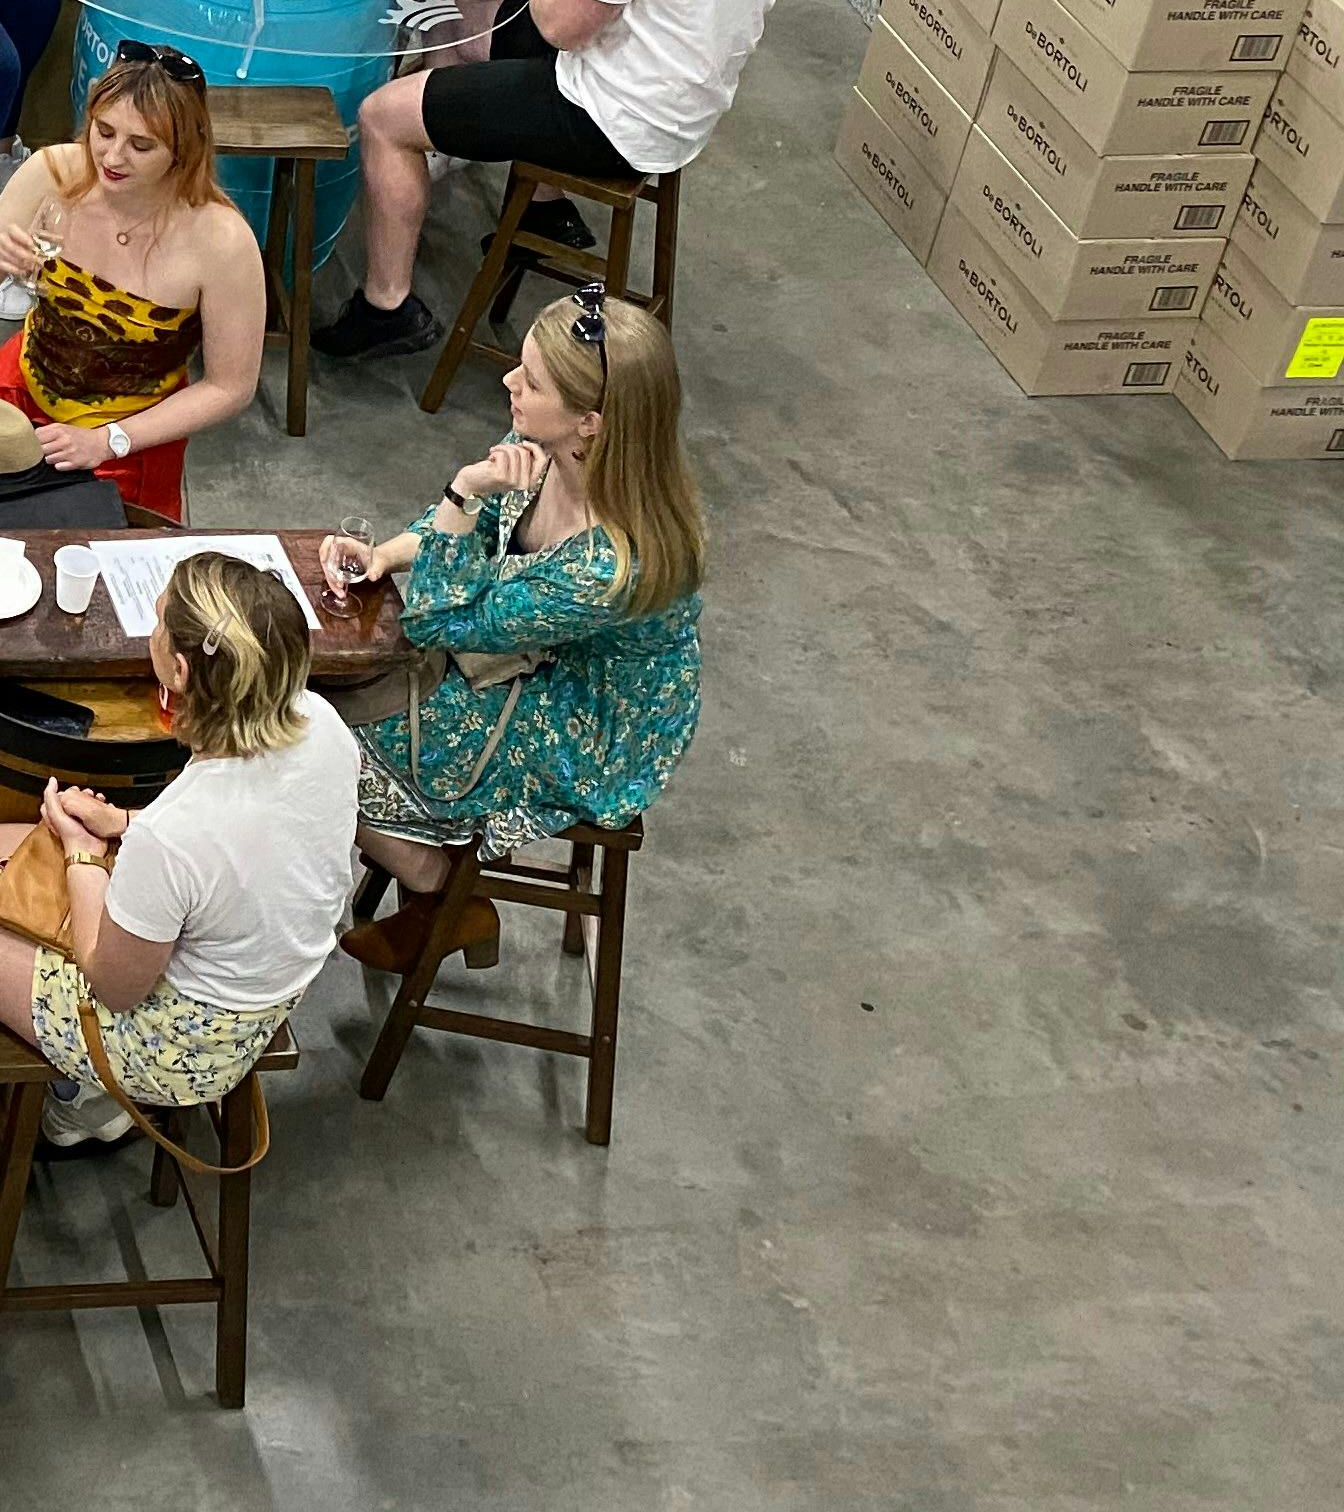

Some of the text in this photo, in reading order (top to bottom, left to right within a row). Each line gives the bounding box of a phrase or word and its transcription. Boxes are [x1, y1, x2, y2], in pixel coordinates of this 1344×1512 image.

[1167, 9, 1284, 21] HANDLE WITH CARE
[1204, 0, 1256, 10] FRAGILE
[919, 5, 962, 61] BORTOLI
[1297, 22, 1342, 69] RTOLI
[1037, 32, 1088, 92] BORTOLI
[1137, 96, 1251, 108] HANDLE WITH CARE
[1173, 86, 1223, 96] FRAGILE
[895, 82, 939, 138] BORTOLI
[1263, 104, 1310, 157] ORTOLI
[1017, 116, 1067, 177] BORTOLI
[872, 153, 914, 210] BORTOLI
[1115, 182, 1228, 193] HANDLE WITH CARE
[1150, 172, 1200, 182] FRAGILE
[993, 197, 1043, 259] BORTOLI
[1241, 194, 1280, 240] RTOLI
[1090, 263, 1199, 275] HANDLE WITH CARE
[1123, 255, 1172, 265] FRAGILE
[969, 271, 1018, 334] BORTOLI
[1213, 274, 1253, 321] RTOLI
[1064, 340, 1172, 351] HANDLE WITH CARE
[1097, 332, 1145, 341] FRAGILE
[1185, 351, 1220, 396] RTOLI
[1270, 407, 1316, 417] HANDLE
[1305, 397, 1344, 406] FRAGIL
